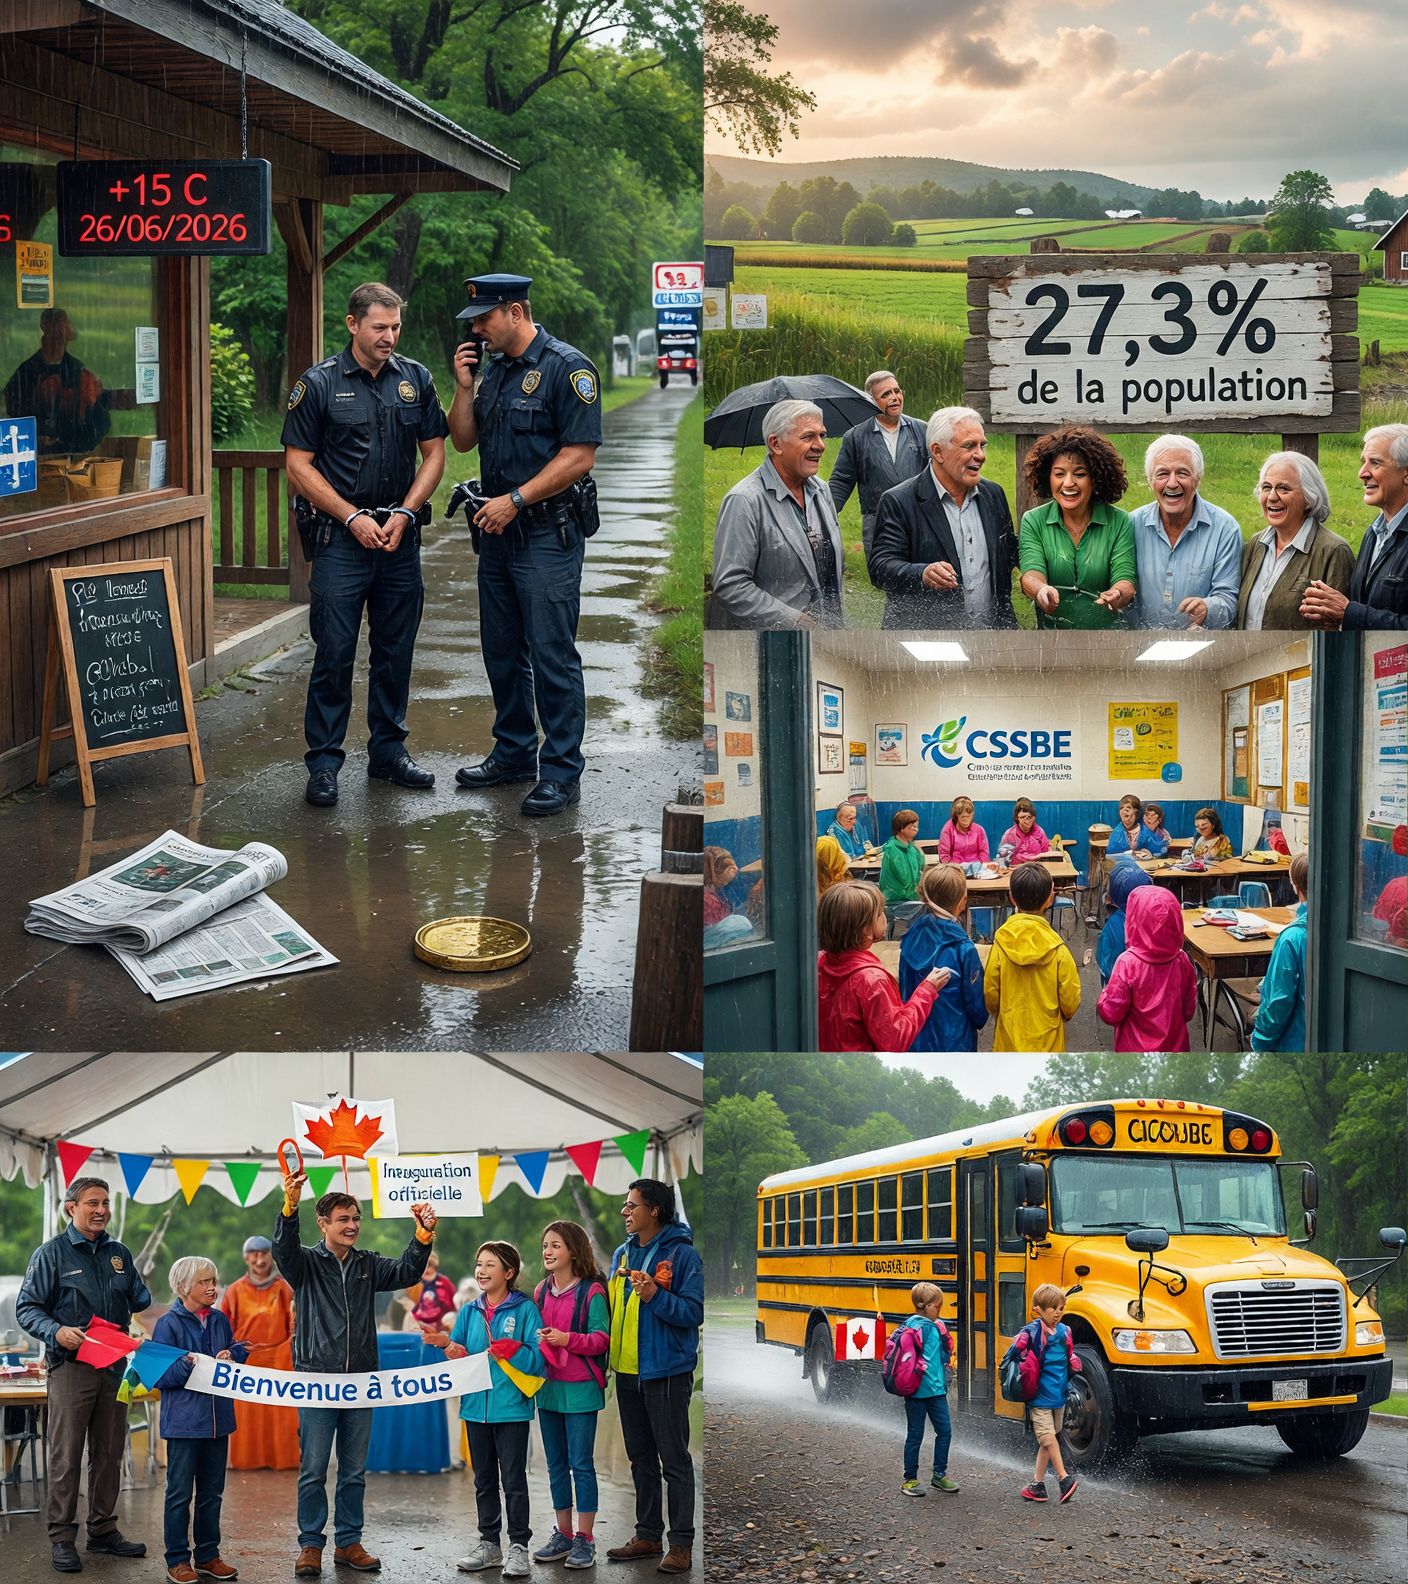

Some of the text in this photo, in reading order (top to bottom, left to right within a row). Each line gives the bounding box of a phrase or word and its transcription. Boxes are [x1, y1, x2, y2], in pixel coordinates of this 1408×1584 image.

[109, 173, 208, 206] +15 C
[79, 213, 248, 242] 26/06/2026
[1024, 277, 1278, 367] 27,3%
[1017, 367, 1308, 415] de la population
[965, 730, 1072, 758] CSSBE
[210, 1361, 358, 1402] Bienvenue
[391, 1372, 452, 1398] tous
